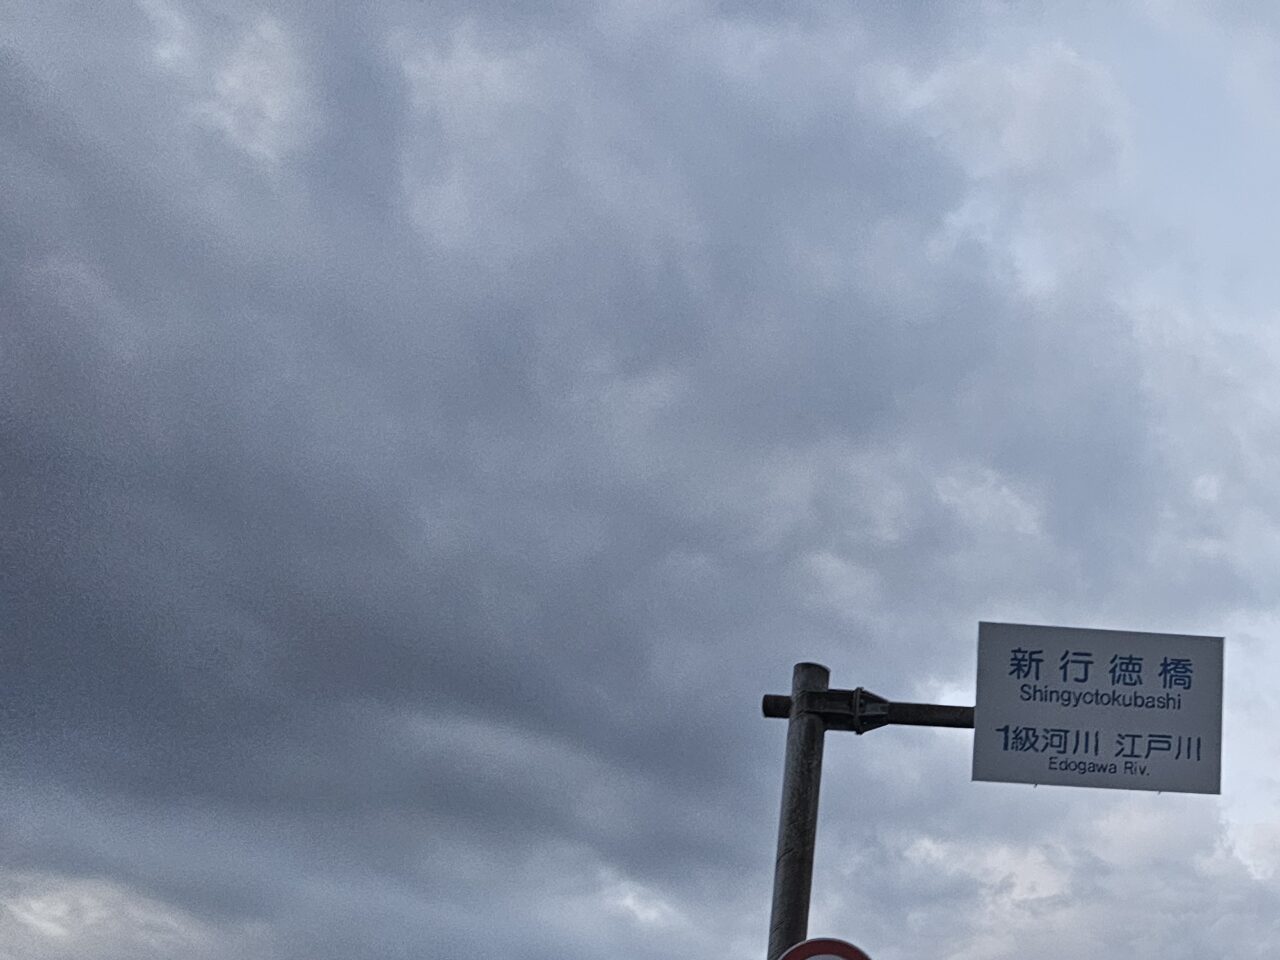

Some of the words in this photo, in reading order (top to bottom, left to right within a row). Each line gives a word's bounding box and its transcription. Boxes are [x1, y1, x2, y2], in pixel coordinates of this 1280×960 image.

[1008, 647, 1194, 690] 新行徳橋
[1020, 684, 1182, 710] Shingyotokubashi
[995, 724, 1099, 757] 1級河川
[1114, 732, 1202, 761] 江戸川
[1048, 757, 1117, 776] Edogawa
[1123, 761, 1150, 776] Riv.
